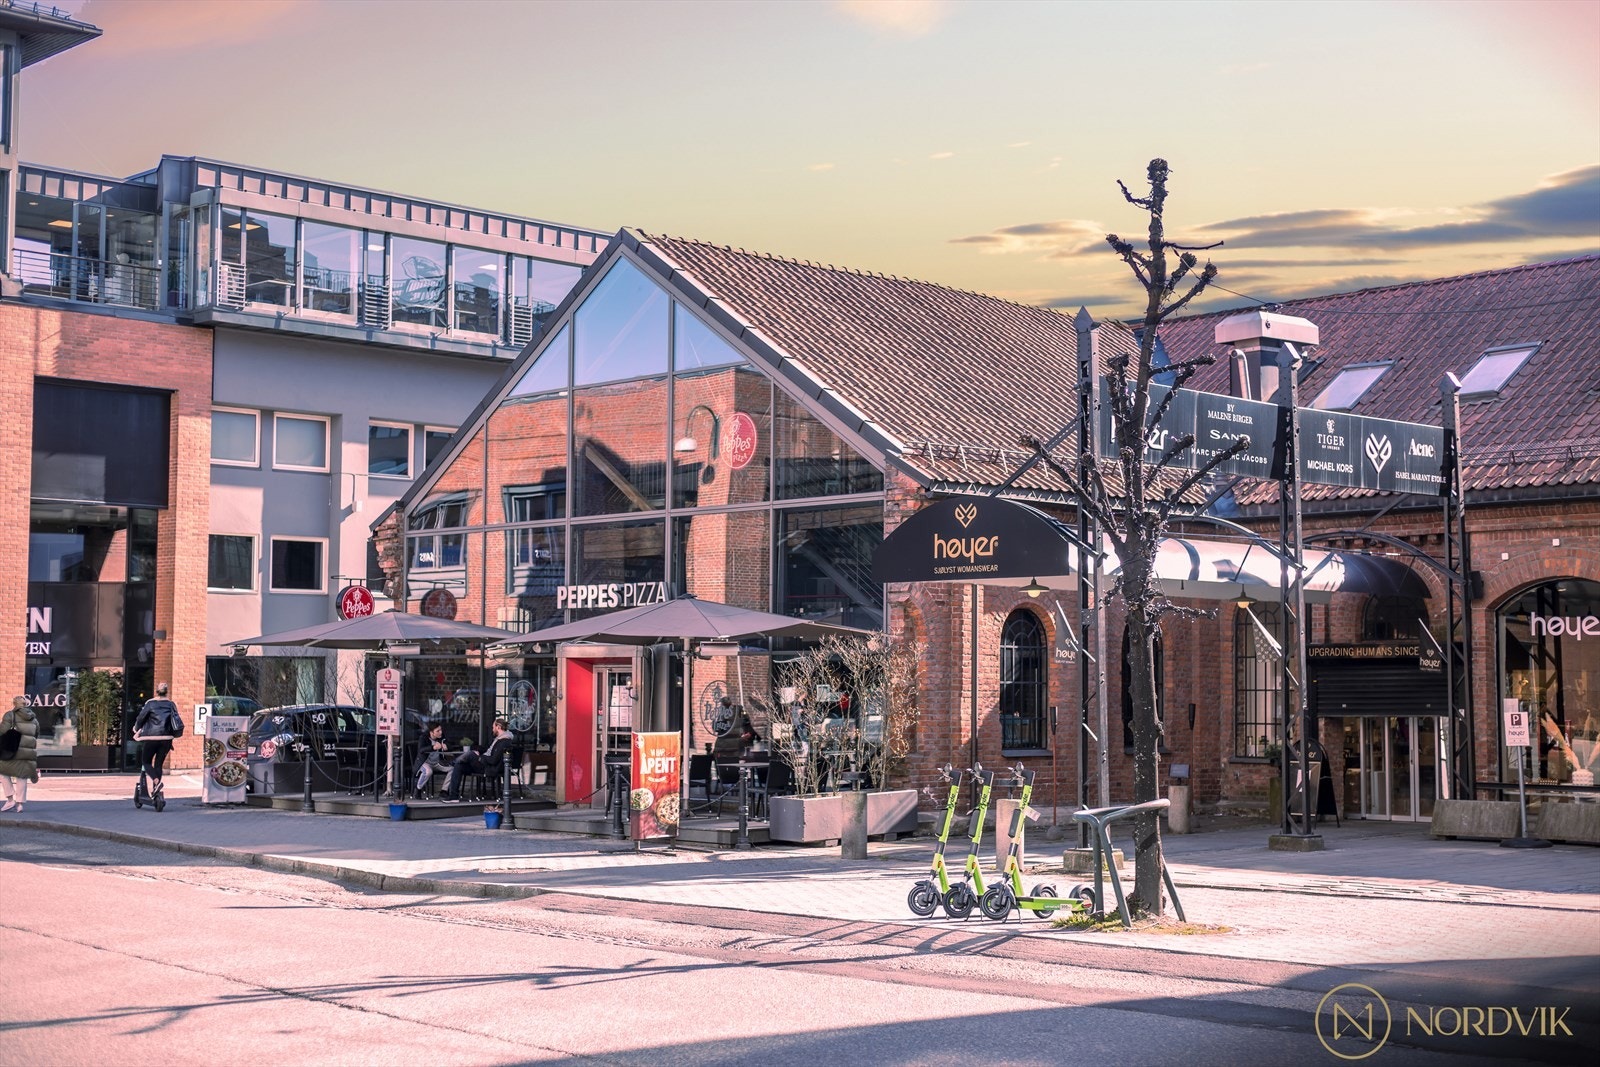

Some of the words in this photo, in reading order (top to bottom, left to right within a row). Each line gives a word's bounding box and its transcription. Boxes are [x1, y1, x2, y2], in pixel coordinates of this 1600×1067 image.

[1227, 404, 1235, 412] BY
[1207, 410, 1231, 421] MALENE
[1233, 413, 1253, 424] BIRGER
[1317, 434, 1345, 446] TIGER
[1409, 438, 1434, 457] Acne
[1242, 453, 1268, 464] JACOBS
[1307, 460, 1335, 472] MICHAEL
[1336, 463, 1353, 474] KORS
[1411, 473, 1430, 481] MARANT
[934, 533, 999, 564] høyer
[934, 566, 956, 574] SJØLYST
[957, 564, 998, 573] WOMANSWEAR
[557, 583, 620, 609] PEPPES
[623, 582, 667, 607] PIZZA
[345, 599, 371, 615] Peppes
[1309, 647, 1354, 656] UPGRADING
[1356, 647, 1393, 656] HUMANS
[1395, 646, 1419, 655] SINCE
[1420, 657, 1440, 668] høyer
[199, 707, 207, 720] P
[1513, 715, 1519, 725] P
[640, 752, 677, 774] ÅPENT
